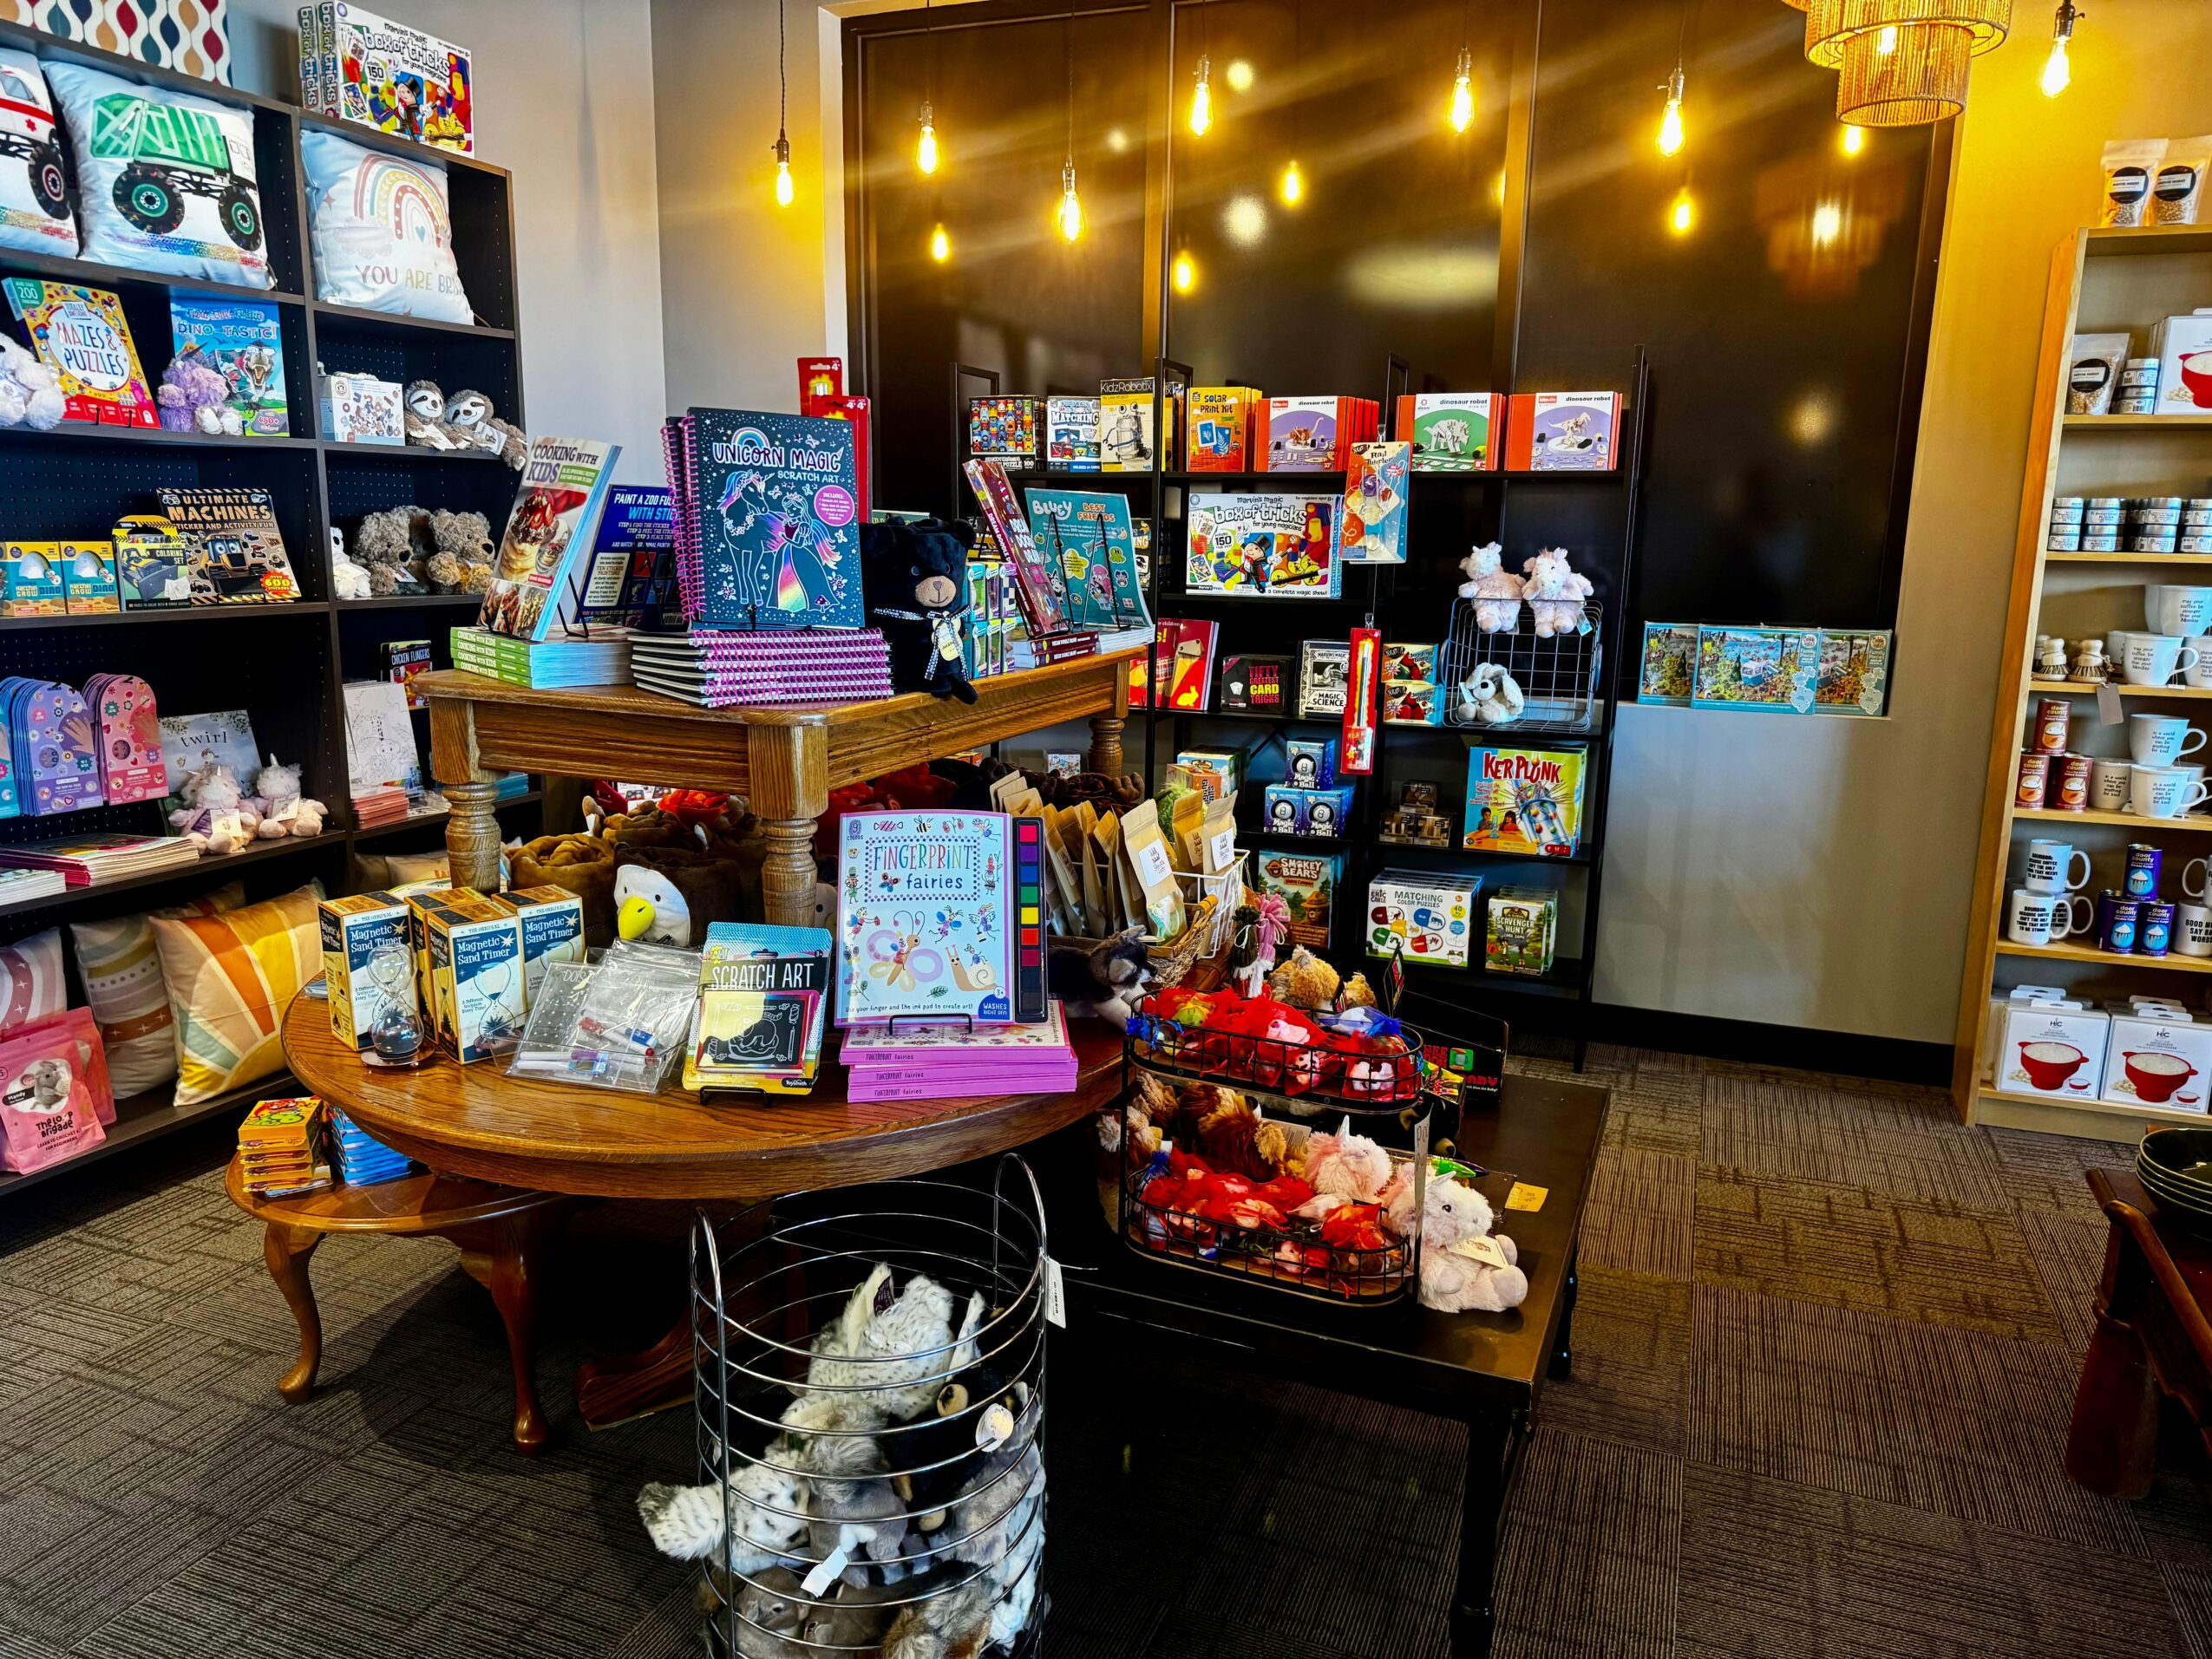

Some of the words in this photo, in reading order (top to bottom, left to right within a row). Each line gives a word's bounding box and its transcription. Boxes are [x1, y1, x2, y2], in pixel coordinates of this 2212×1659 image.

[301, 6, 312, 40] box
[322, 2, 334, 40] box
[363, 26, 393, 52] box
[393, 36, 406, 56] of
[404, 39, 450, 77] tricks
[324, 52, 337, 101] tricks
[368, 65, 385, 79] 150
[304, 54, 317, 106] tricks
[355, 265, 398, 284] YOU
[405, 268, 432, 291] ARE
[17, 287, 38, 299] 200
[56, 322, 105, 349] MAZES
[106, 334, 117, 352] &
[64, 349, 125, 376] PUZZLES
[1101, 382, 1152, 394] KidzRobotix
[1050, 411, 1100, 425] MATCHING
[533, 444, 578, 462] COOKING
[576, 452, 599, 466] WITH
[712, 443, 784, 467] UNICORN
[790, 446, 844, 472] MAGIC
[526, 461, 561, 483] KIDS
[778, 471, 820, 481] SCRATCH
[183, 495, 249, 506] ULTIMATE
[614, 493, 638, 504] PAINT
[638, 495, 644, 504] A
[644, 495, 658, 505] ZOO
[167, 505, 272, 521] MACHINES
[628, 506, 653, 520] WITH
[1083, 503, 1105, 513] BEST
[1214, 506, 1245, 524] box
[1244, 505, 1258, 519] of
[1258, 502, 1307, 526] tricks
[1215, 536, 1232, 545] 150
[155, 549, 183, 558] COLORING
[265, 577, 292, 587] 600
[458, 630, 476, 642] COOKING
[485, 637, 496, 647] KIDS
[458, 641, 476, 653] COOKING
[485, 647, 496, 658] KIDS
[391, 651, 410, 666] CHICKEN
[458, 651, 477, 663] COOKING
[486, 658, 497, 669] KIDS
[461, 661, 478, 674] COOKING
[488, 668, 498, 678] KIDS
[1249, 666, 1279, 677] FIFTY
[1250, 684, 1279, 695] CARD
[1250, 695, 1280, 704] TRICKS
[1312, 698, 1344, 707] SCIENCE
[180, 731, 227, 748] twirl
[1281, 858, 1322, 871] SMOKEY
[906, 873, 963, 889] fairies
[1395, 891, 1443, 903] MATCHING
[479, 924, 501, 933] ORIGINAL
[526, 917, 565, 933] Magnetic
[1496, 917, 1535, 928] SCAVENGER
[1506, 925, 1524, 934] HUNT
[350, 924, 392, 942] Magnetic
[526, 932, 547, 944] Sand
[548, 928, 574, 939] Timer
[350, 940, 374, 953] Sand
[457, 937, 500, 953] Magnetic
[458, 952, 480, 965] Sand
[482, 948, 510, 961] Timer
[711, 963, 776, 990] SCRATCH
[782, 963, 814, 988] ART
[870, 1004, 887, 1013] finger
[923, 1003, 933, 1011] pad
[8, 1092, 25, 1101] Mandy
